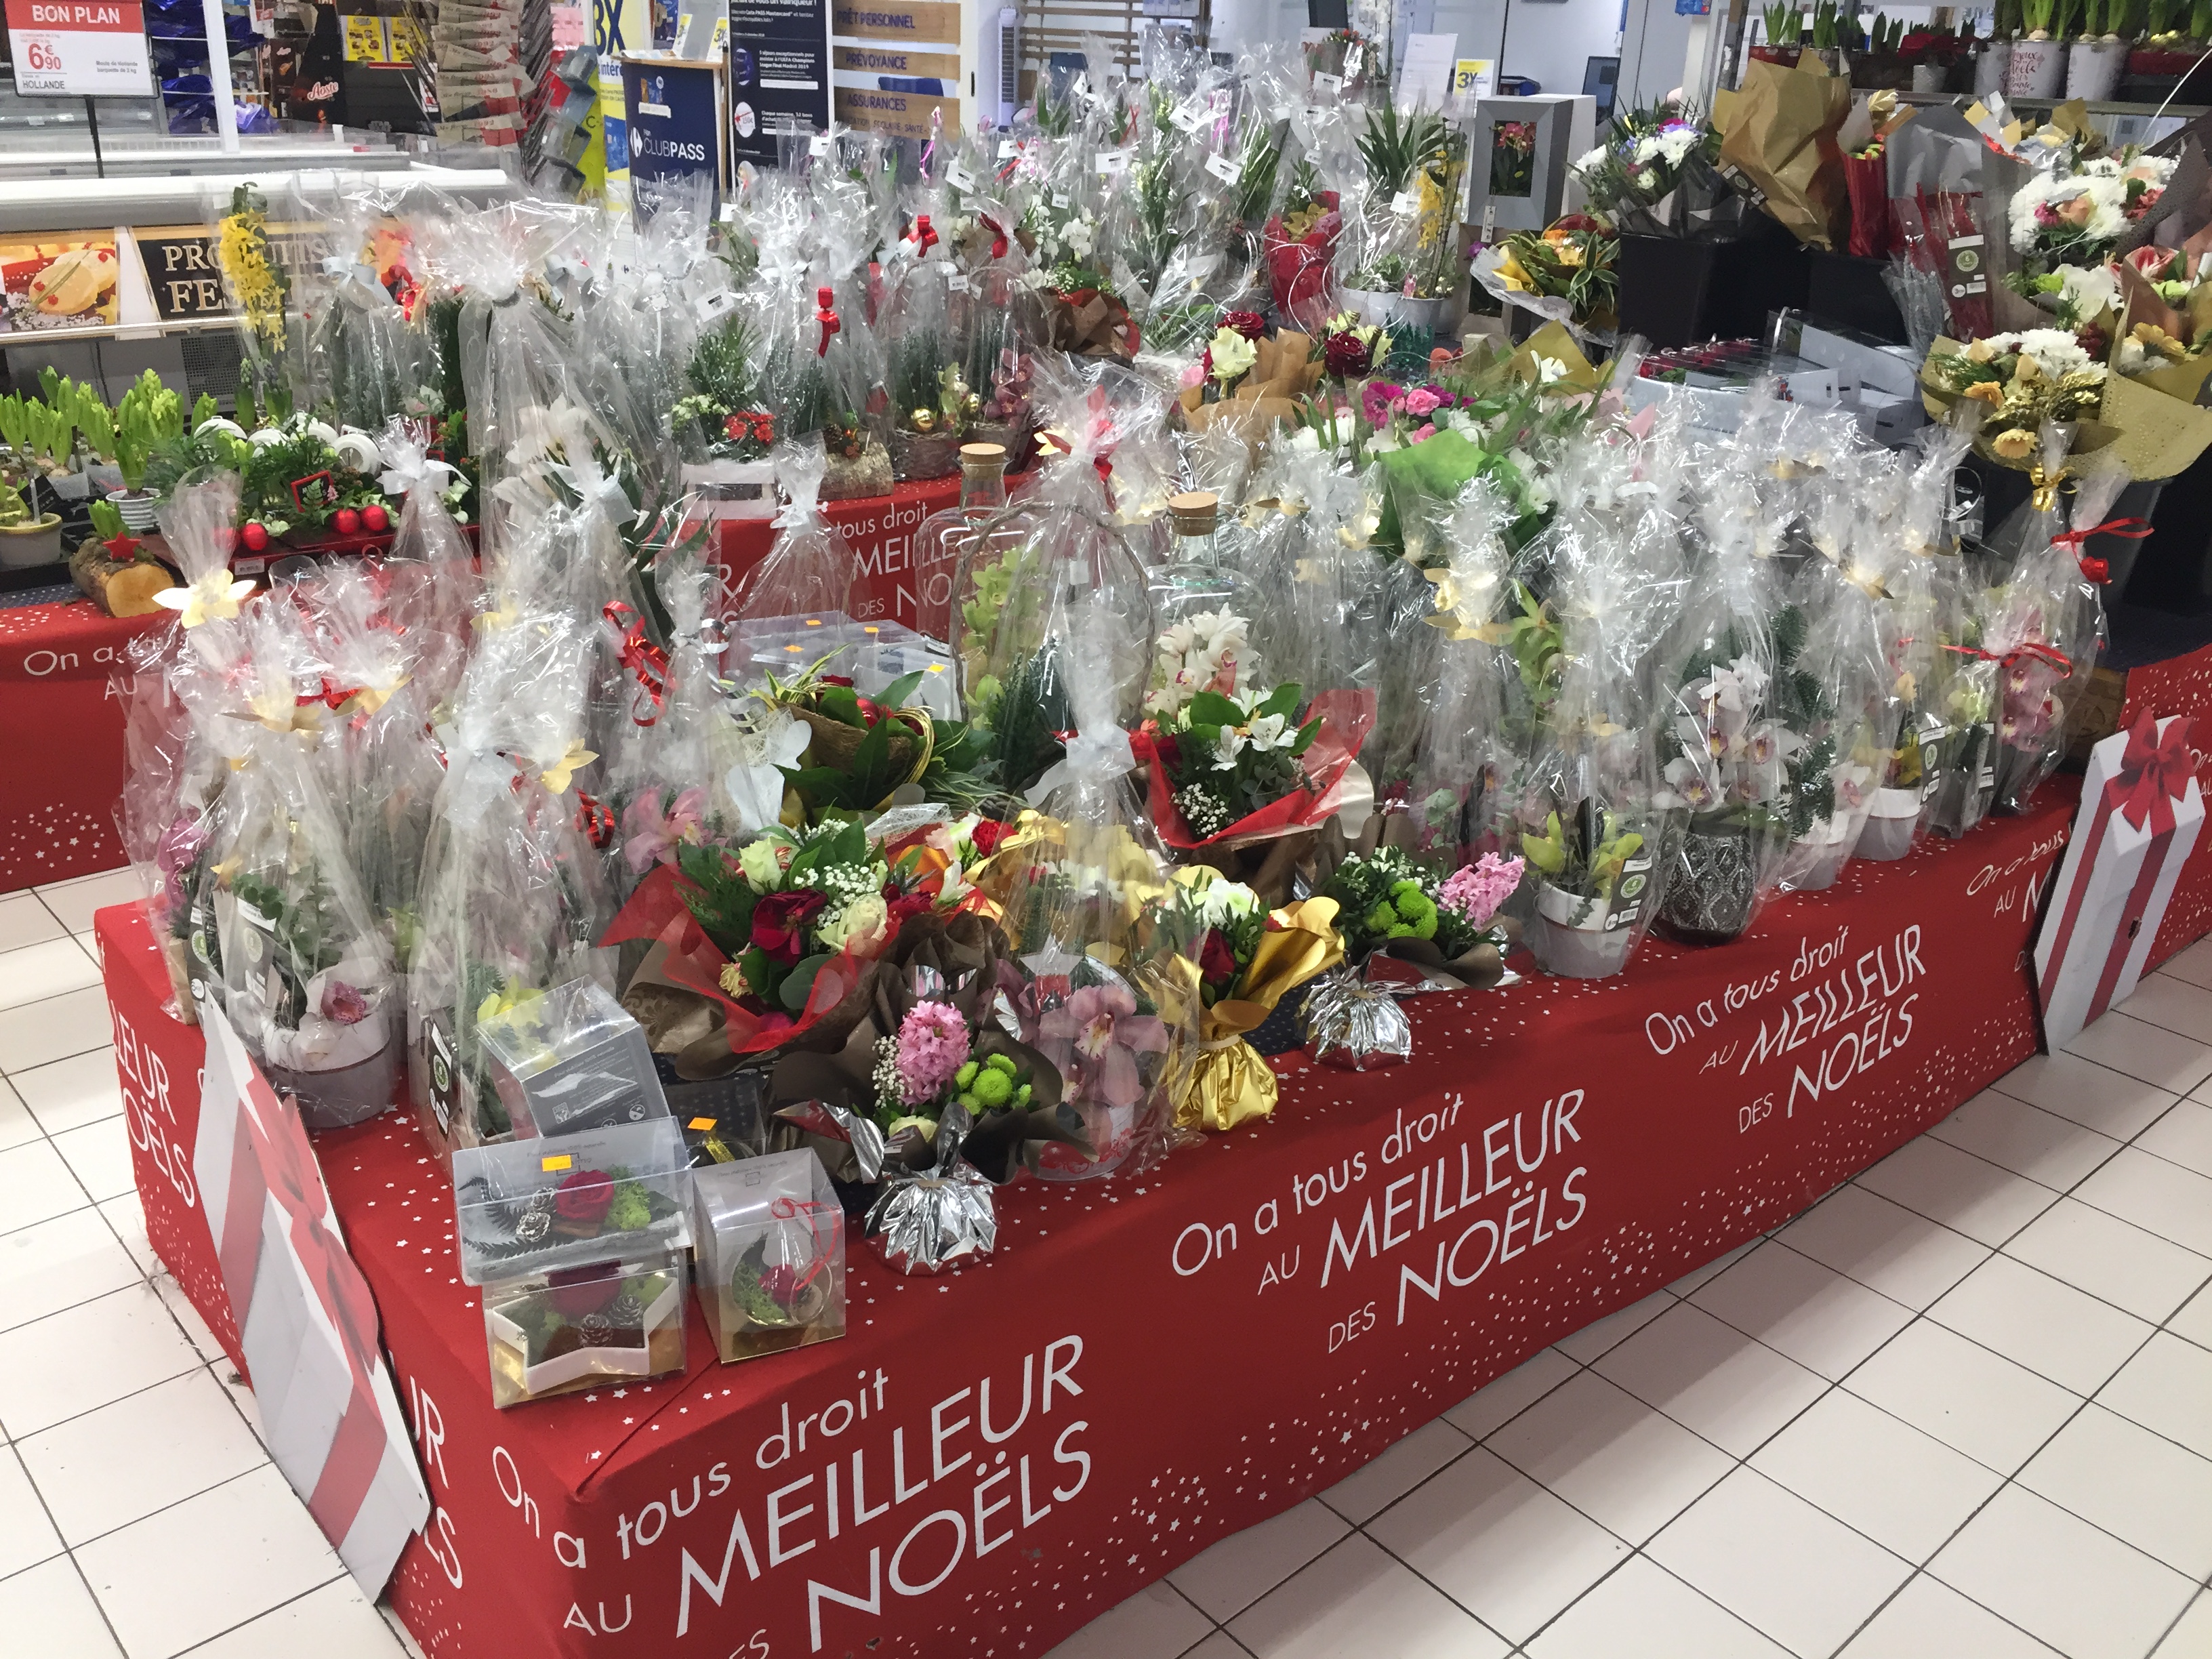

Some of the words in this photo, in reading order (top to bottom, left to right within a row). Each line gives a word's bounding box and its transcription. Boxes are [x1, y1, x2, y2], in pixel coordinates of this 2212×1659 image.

[33, 5, 70, 22] BON
[75, 7, 120, 24] PLAN
[860, 12, 915, 29] PERSONNEL
[846, 50, 907, 70] PRÉVOYANCE
[22, 80, 65, 89] HOLLANDE
[307, 82, 338, 100] Aoste
[847, 94, 907, 112] ASSURANCES
[883, 500, 928, 530] droit
[858, 598, 885, 619] DES
[24, 650, 79, 676] On
[93, 646, 113, 663] a
[104, 675, 138, 701] AU
[1967, 864, 2003, 896] On
[2005, 855, 2025, 876] a
[2024, 830, 2064, 865] tous
[1994, 885, 2017, 918] AU
[1645, 1012, 1696, 1055] On
[1696, 999, 1719, 1027] a
[1723, 969, 1781, 1015] tous
[1790, 925, 1849, 983] droit
[1699, 1040, 1739, 1076] AU
[1739, 924, 1927, 1076] MEILLEUR
[1739, 1092, 1774, 1134] DES
[1787, 993, 1919, 1119] NOËLS
[1172, 1223, 1237, 1276] On
[1254, 1199, 1278, 1235] a
[1293, 1151, 1367, 1214] tous
[1382, 1092, 1464, 1164] droit
[1258, 1245, 1300, 1296] AU
[1321, 1088, 1584, 1288] MEILLEUR
[1328, 1301, 1376, 1354] DES
[1397, 1166, 1587, 1326] NOËLS
[493, 1446, 540, 1539] On
[553, 1531, 587, 1570] a
[617, 1462, 731, 1560] tous
[756, 1367, 888, 1470] droit
[563, 1593, 632, 1637] AU
[676, 1334, 1084, 1639] MEILLEUR
[808, 1420, 1091, 1654] NOËLS
